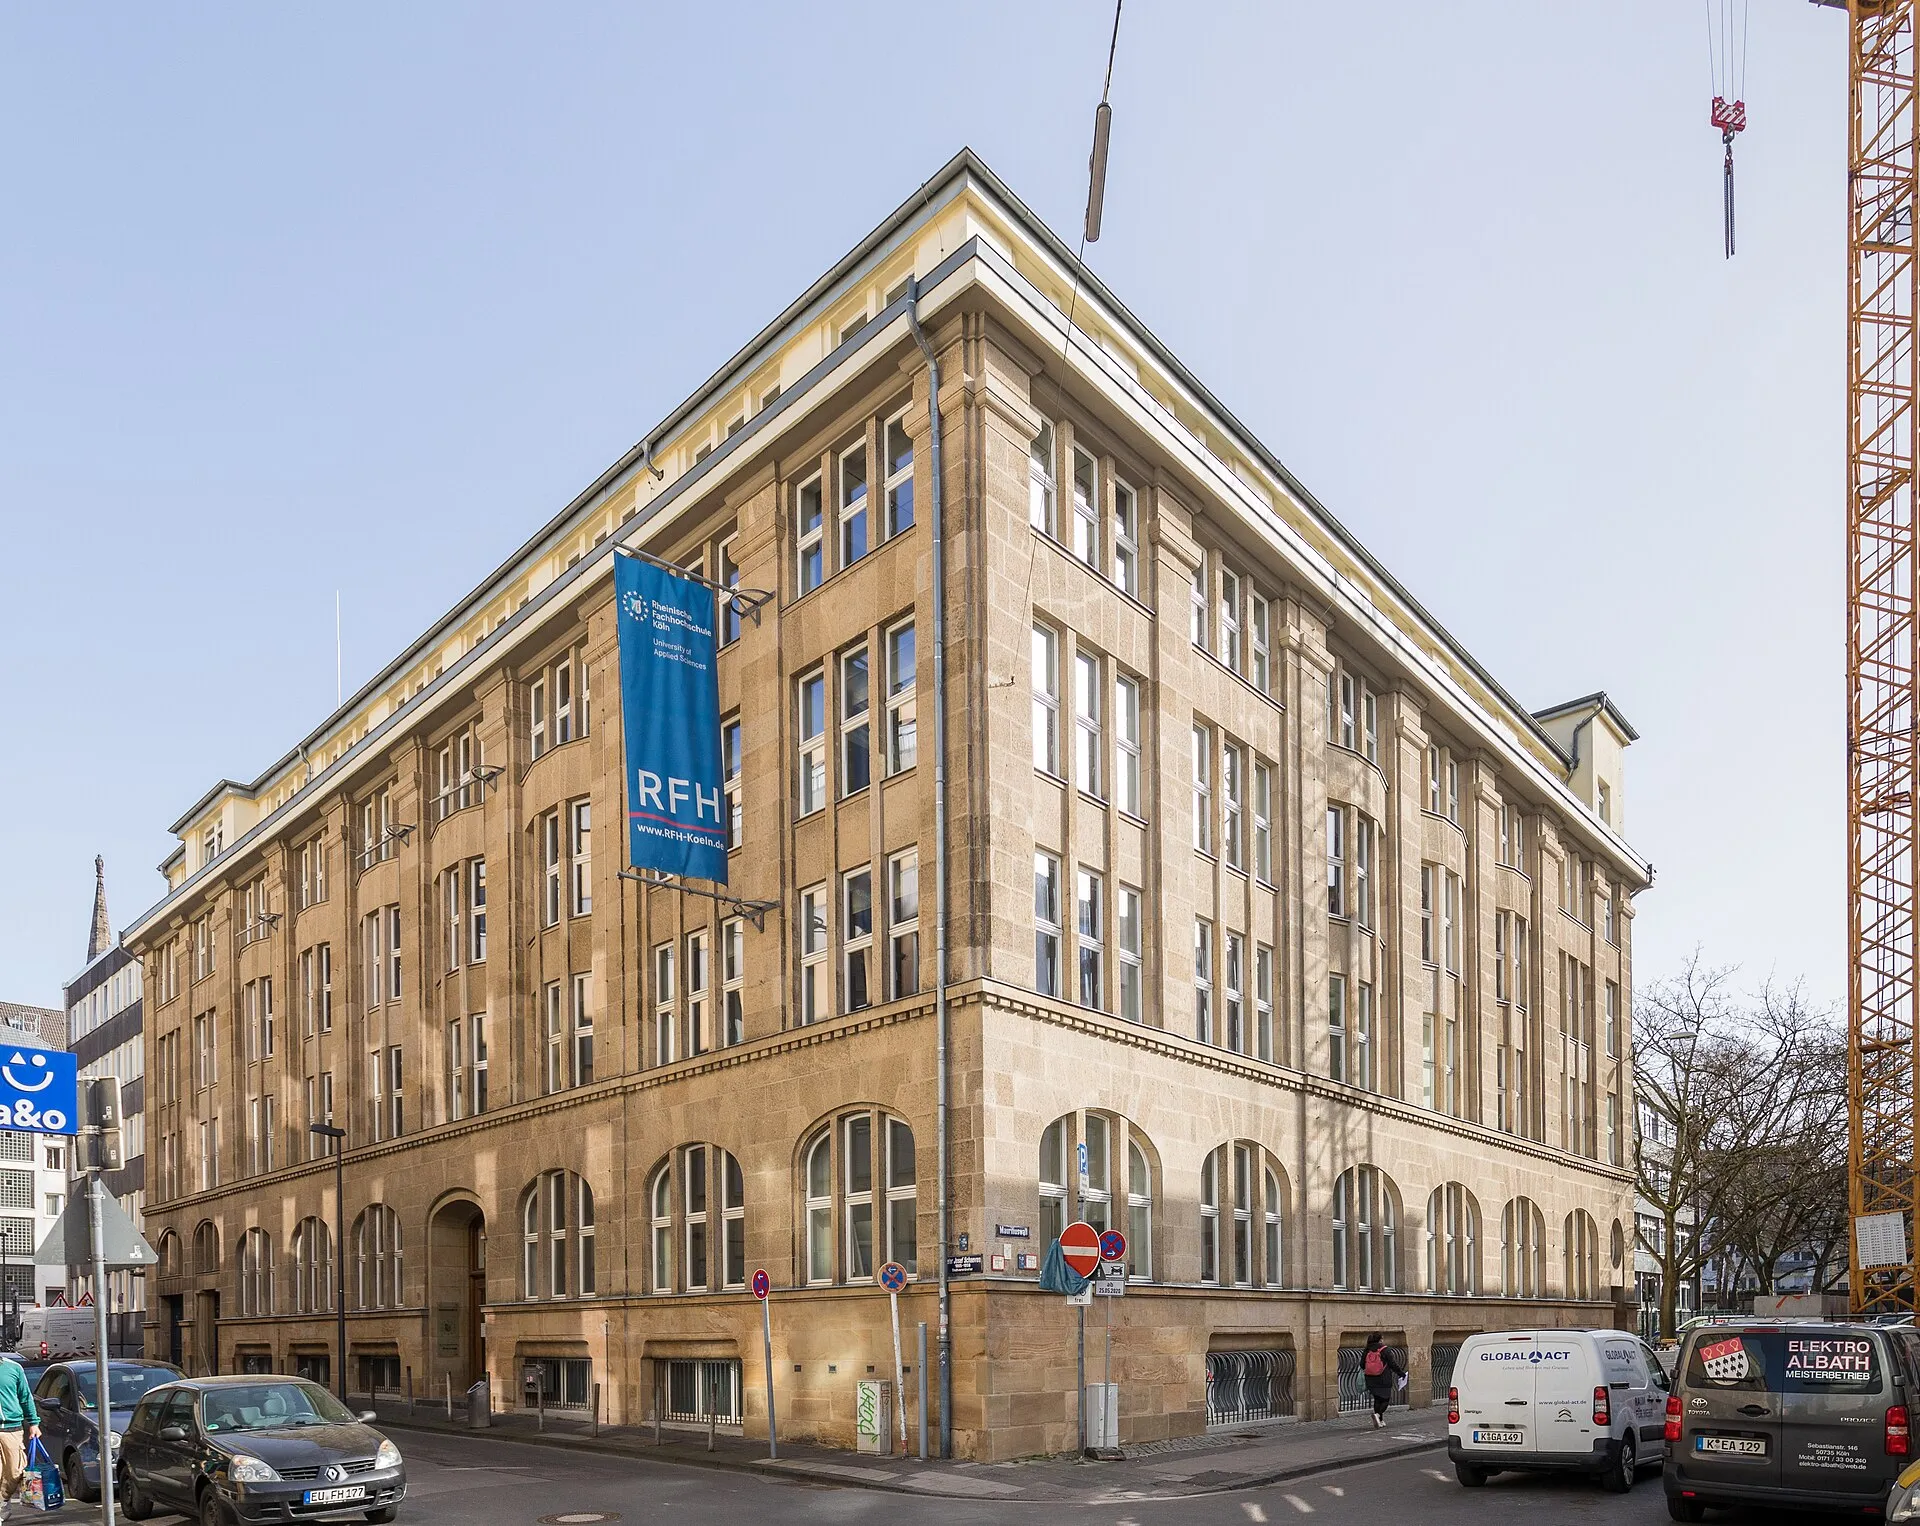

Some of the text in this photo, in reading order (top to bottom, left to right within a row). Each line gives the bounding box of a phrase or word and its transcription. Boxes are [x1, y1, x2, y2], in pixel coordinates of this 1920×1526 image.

[651, 599, 692, 621] Rheinische
[652, 609, 712, 637] Fachhochschule
[652, 619, 670, 632] Köln
[653, 637, 692, 656] University of
[653, 648, 707, 671] Applied Sciences
[638, 768, 720, 824] RFH
[636, 823, 725, 851] www.RFH-Koeln.de
[1788, 1340, 1870, 1354] ELEKTRO
[1480, 1351, 1571, 1361] GLOBAL ACT
[1787, 1354, 1870, 1371] ALBATH
[1785, 1370, 1870, 1381] MEISTERBETRIEB
[1480, 1432, 1519, 1442] K GA 149
[1706, 1439, 1761, 1453] K EA 129
[1807, 1442, 1846, 1451] Sebastianstr.
[1836, 1449, 1850, 1457] Köln
[1798, 1460, 1867, 1470] elektro-albath@web.de
[311, 1487, 364, 1502] EU FH 177
